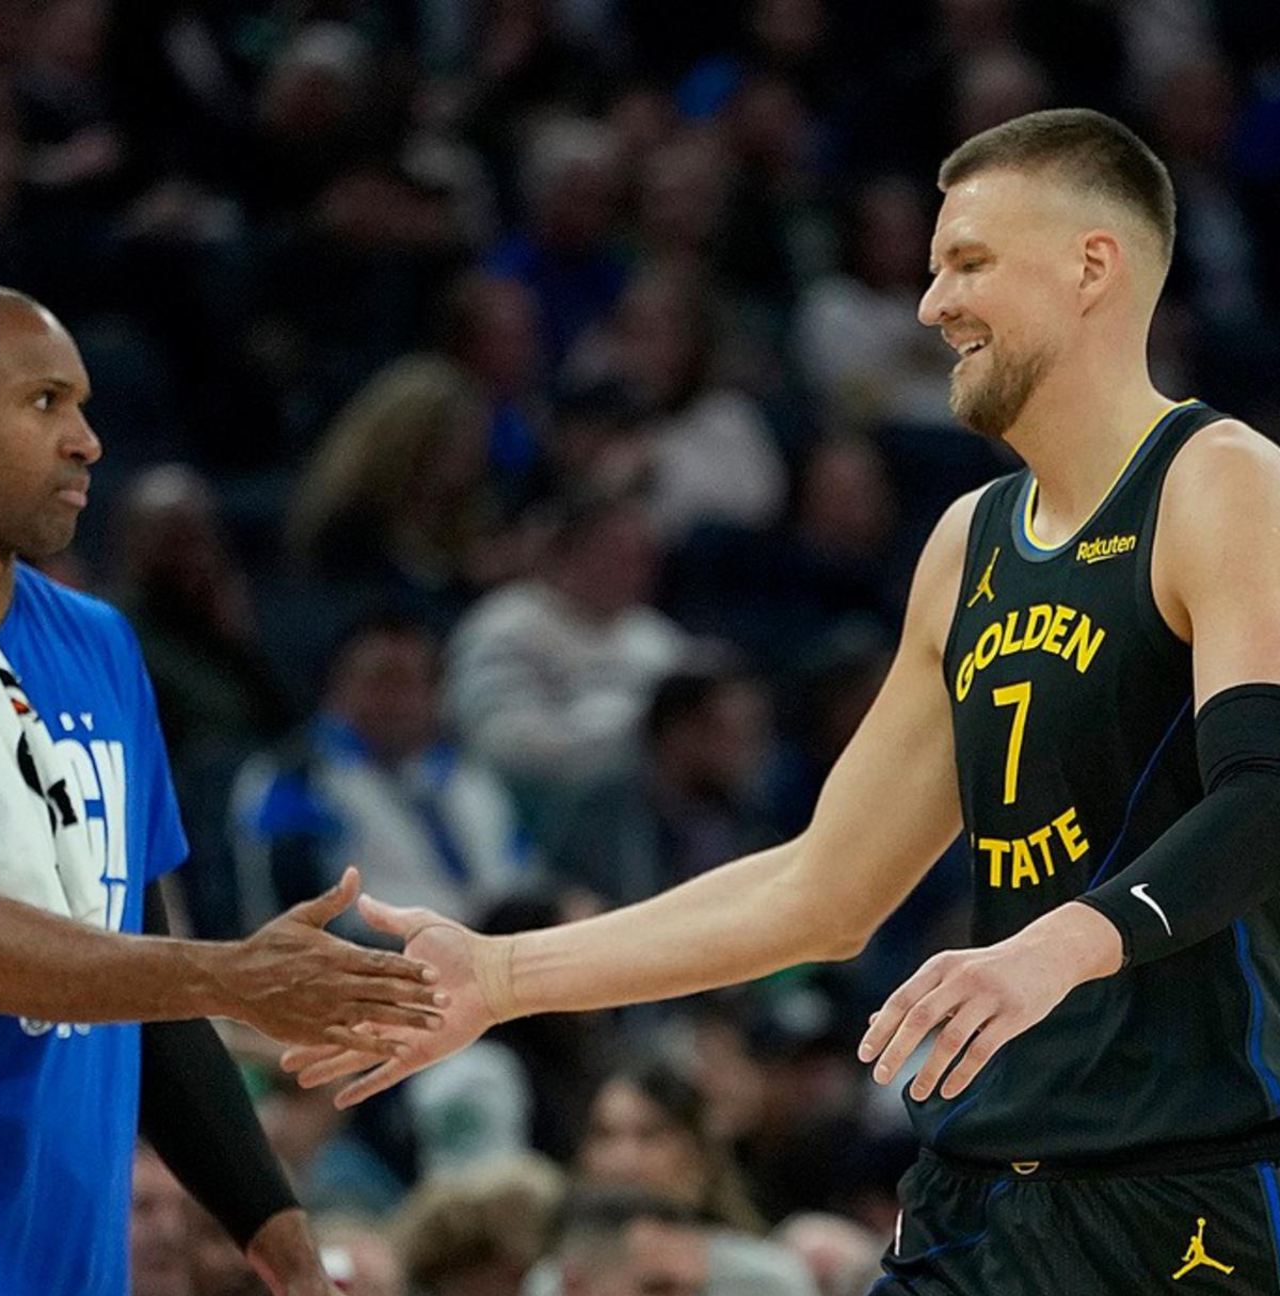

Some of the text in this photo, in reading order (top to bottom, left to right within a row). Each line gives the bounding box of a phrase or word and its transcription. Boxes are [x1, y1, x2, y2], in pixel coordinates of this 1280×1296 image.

[1076, 535, 1136, 561] Rakuten
[956, 604, 1106, 702] GOLDEN
[992, 681, 1032, 805] 7
[970, 806, 1090, 889] TATE
